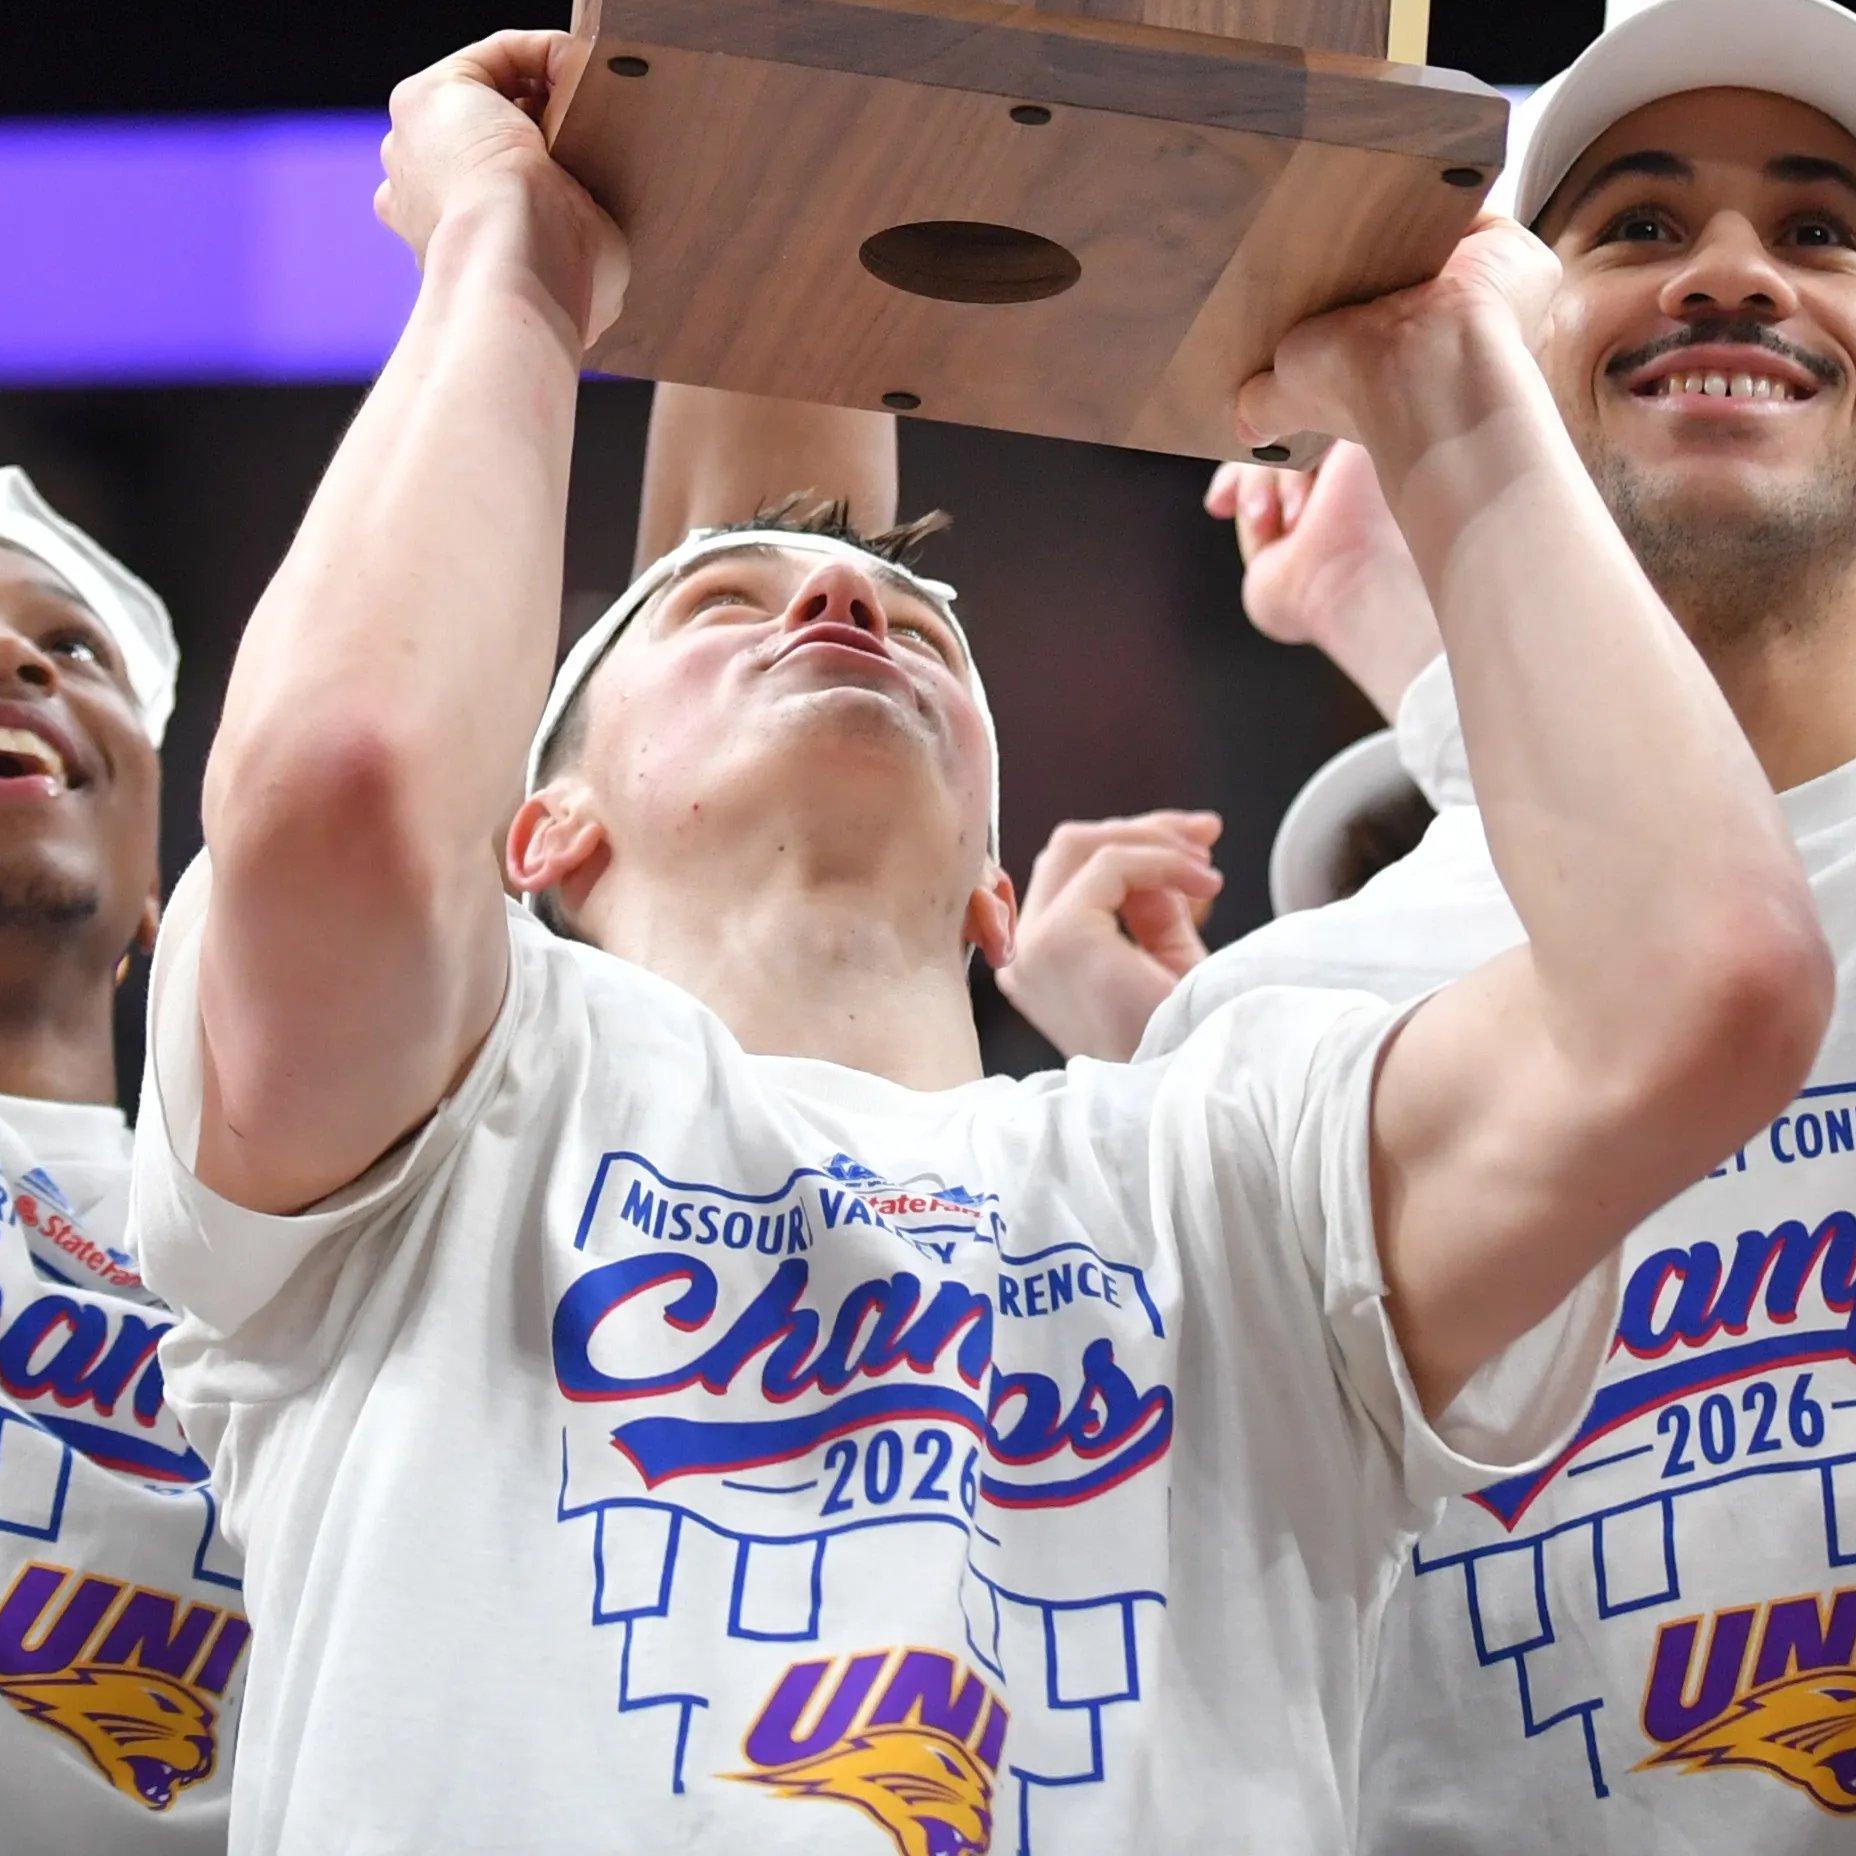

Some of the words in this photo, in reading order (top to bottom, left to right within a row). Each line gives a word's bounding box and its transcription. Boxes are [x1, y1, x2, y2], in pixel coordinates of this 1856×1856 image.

[820, 1429, 978, 1520] 2026
[1655, 1372, 1826, 1479] 2026
[741, 1646, 1010, 1777] UNI
